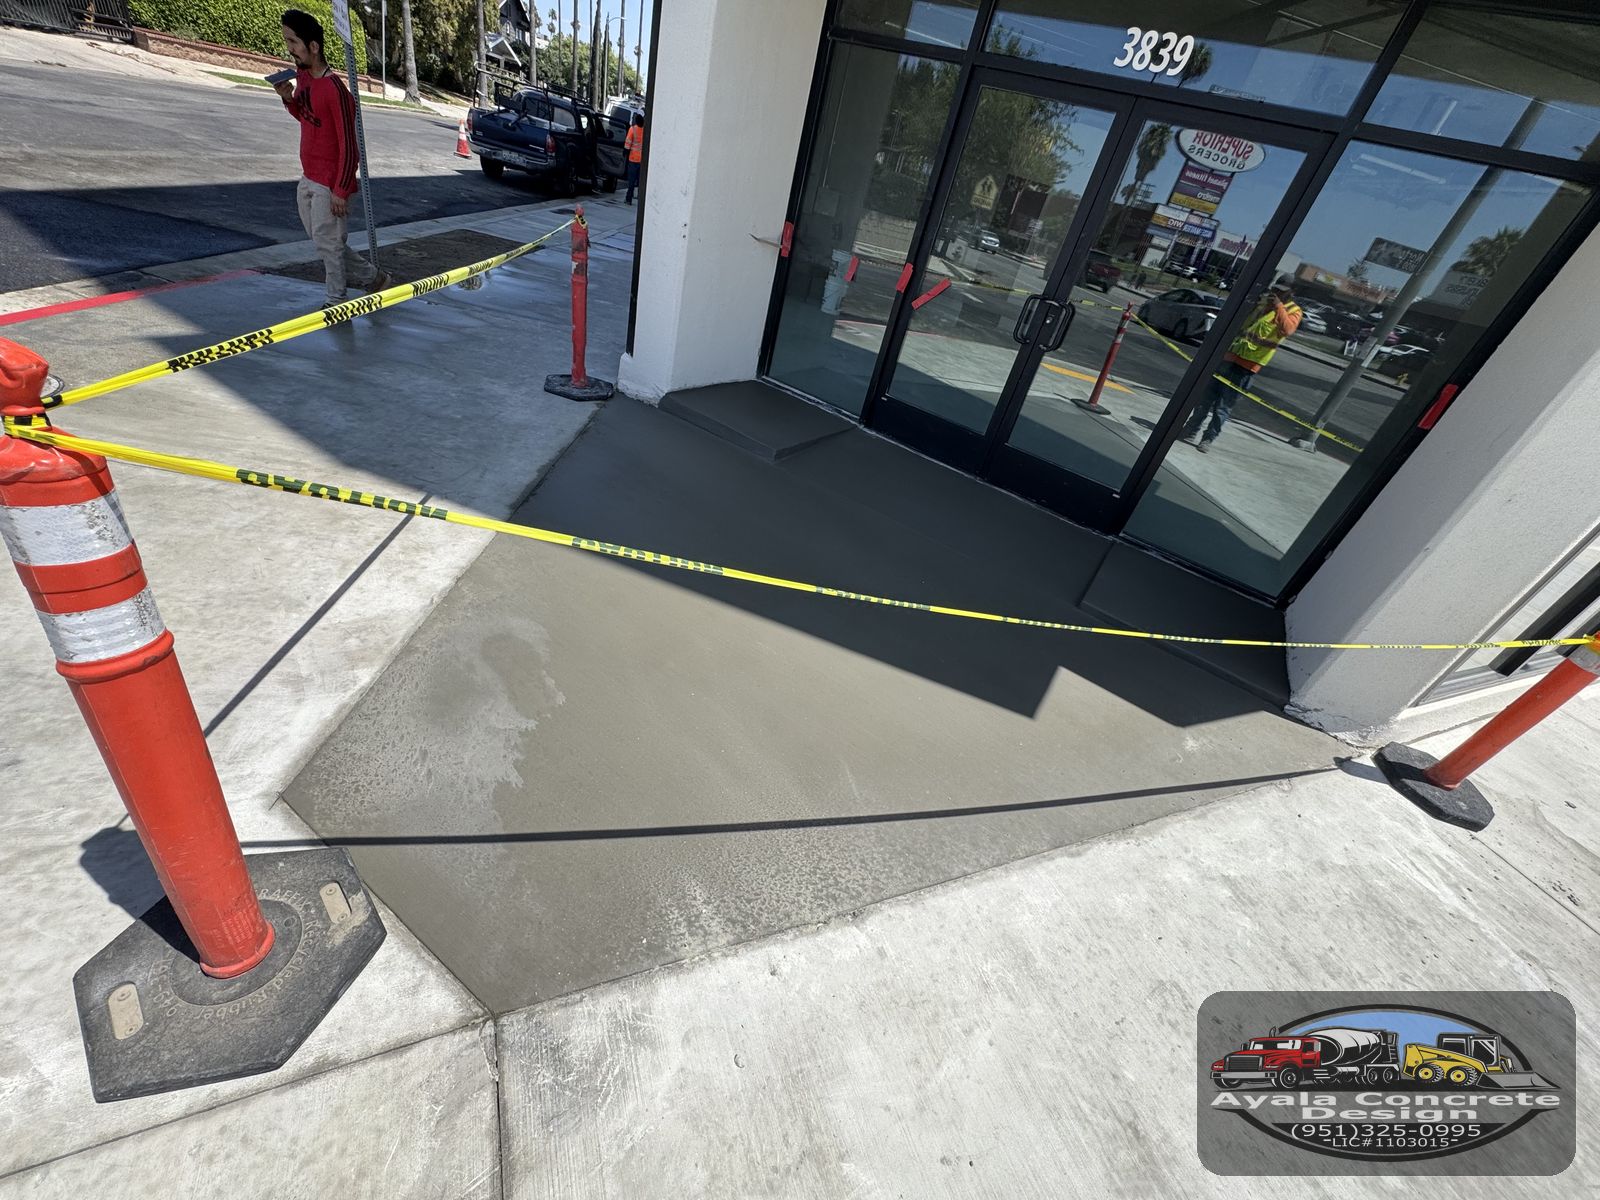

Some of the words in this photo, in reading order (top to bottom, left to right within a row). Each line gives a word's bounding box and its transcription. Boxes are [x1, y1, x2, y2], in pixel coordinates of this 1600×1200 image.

[1113, 26, 1195, 76] 3839
[412, 273, 450, 297] CAUTION
[254, 888, 312, 912] RAFFIX
